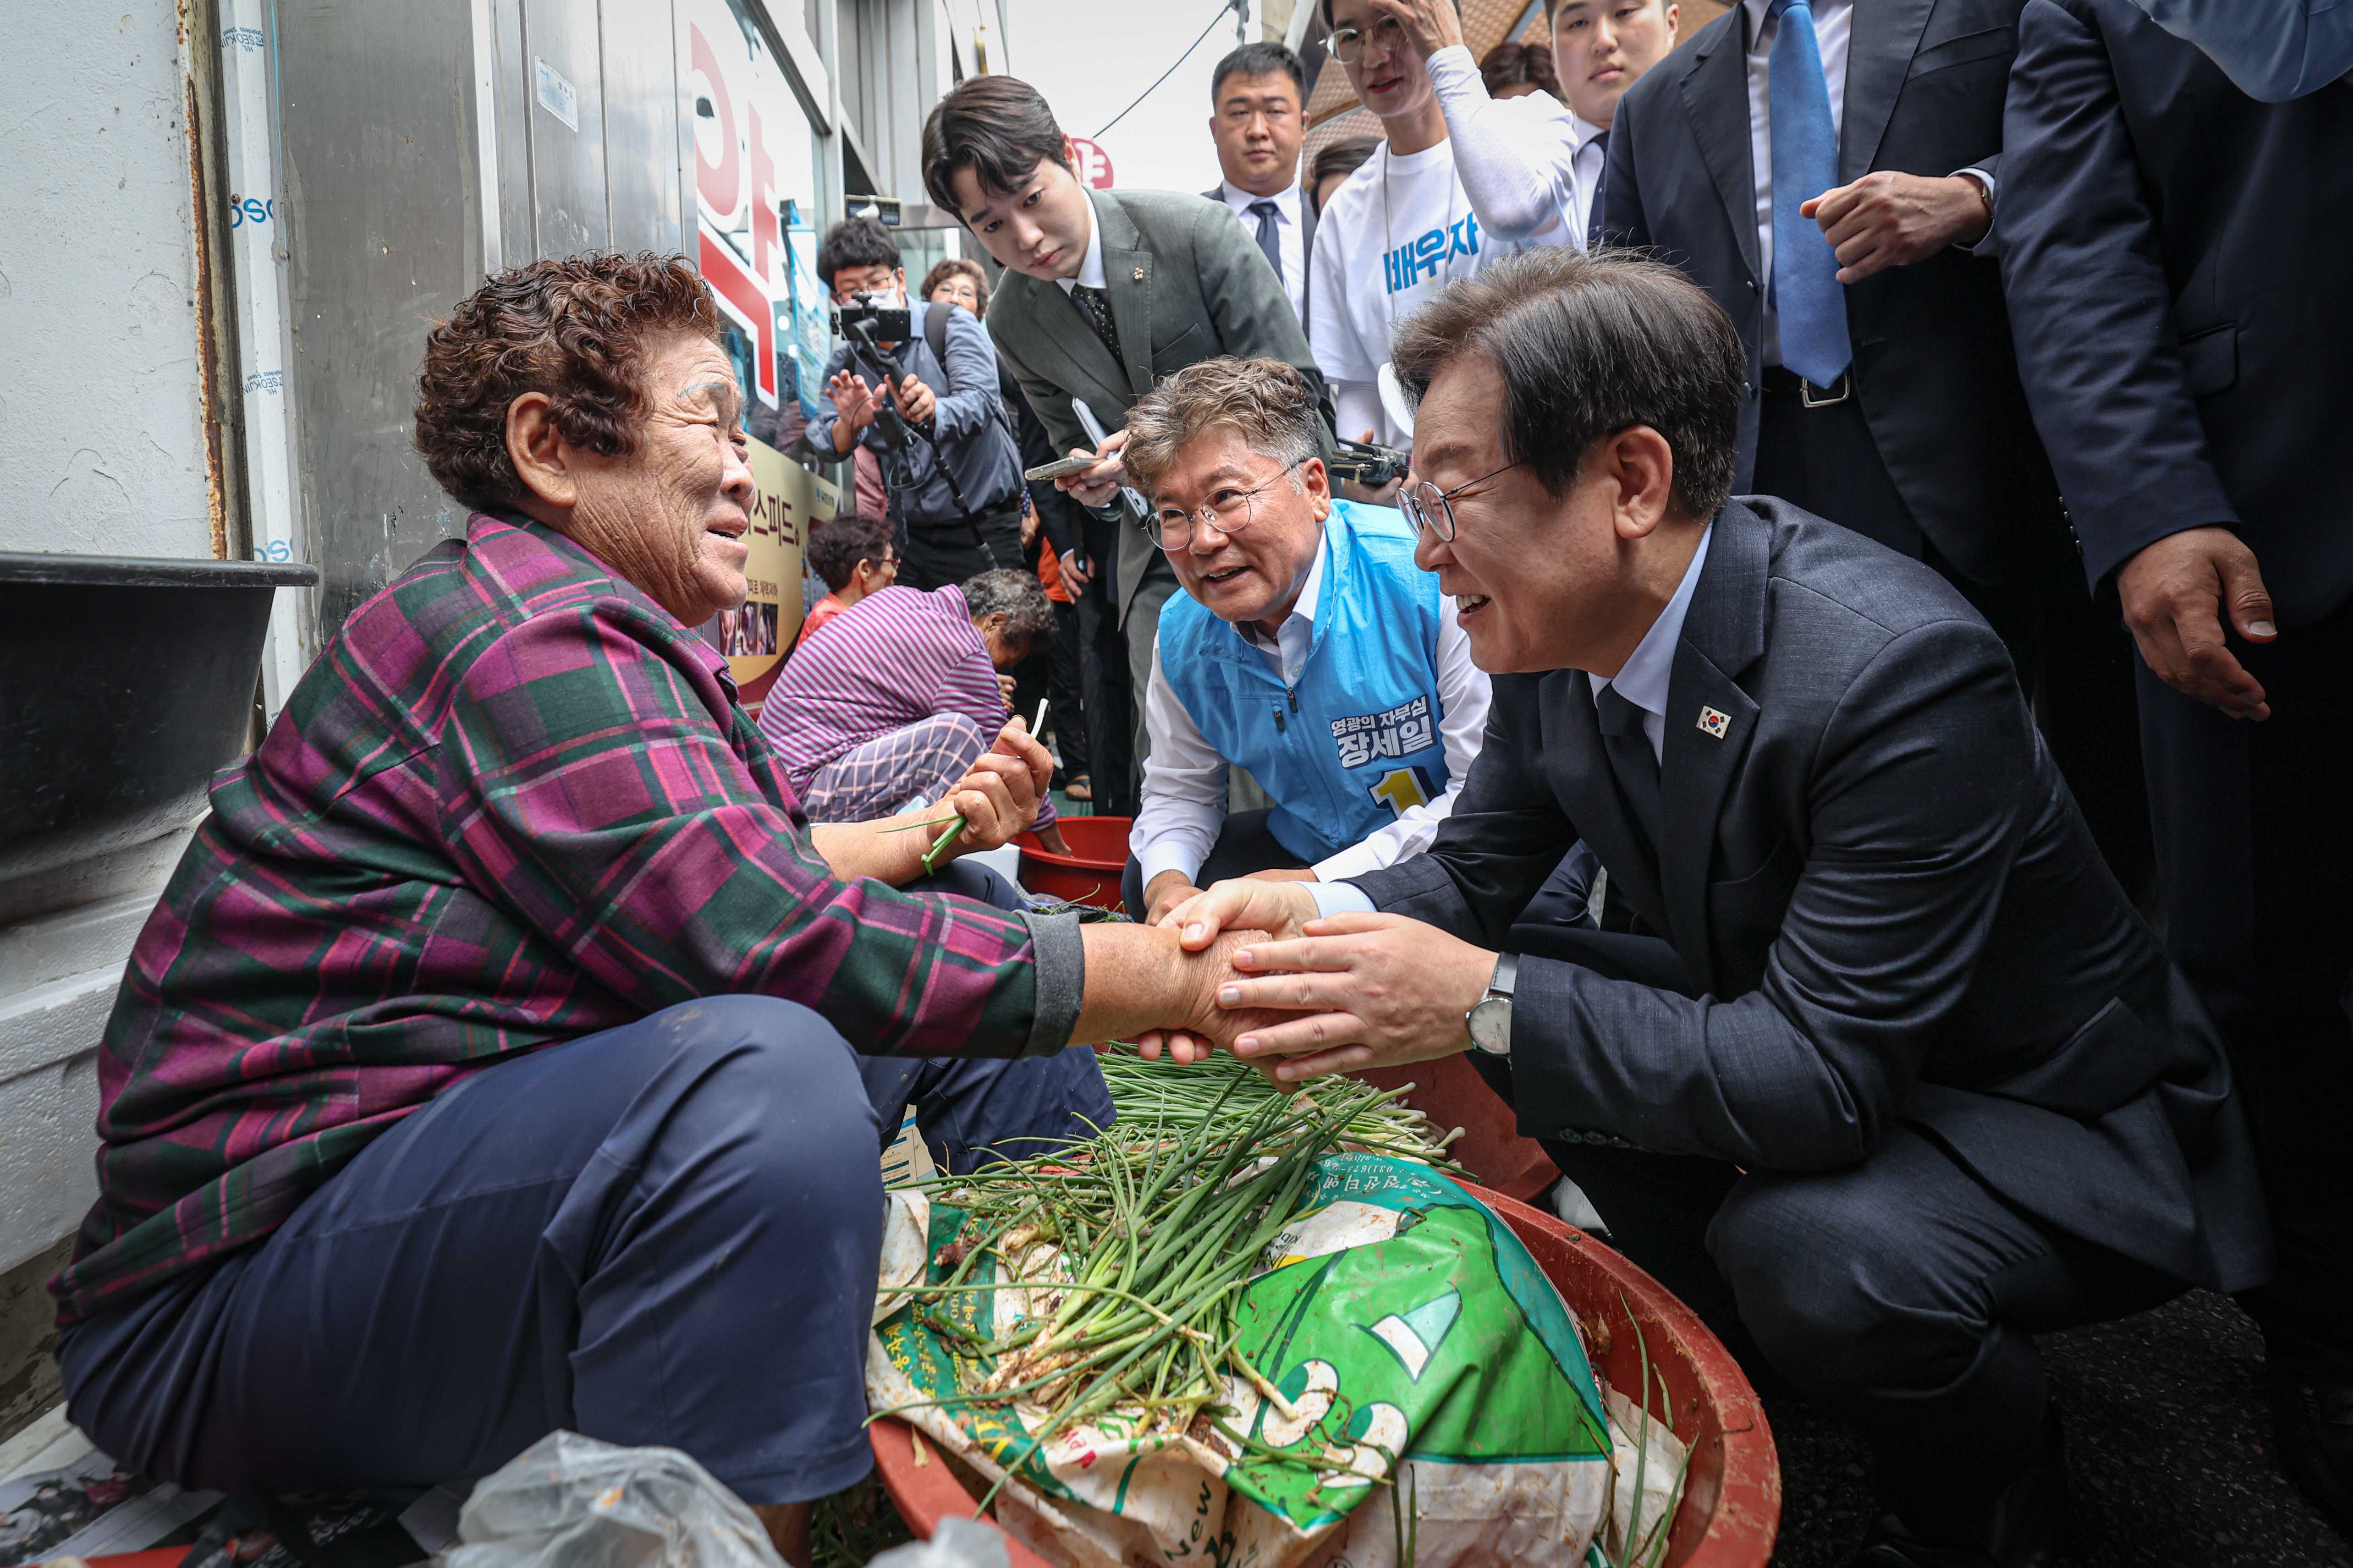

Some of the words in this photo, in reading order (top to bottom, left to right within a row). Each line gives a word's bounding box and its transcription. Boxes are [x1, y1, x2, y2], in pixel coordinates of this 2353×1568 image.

[1383, 209, 1480, 295] 배우자
[1331, 715, 1376, 737] 영광의
[1379, 696, 1427, 727] 자부심
[1337, 714, 1434, 768] 장세일
[1369, 766, 1430, 821] 1
